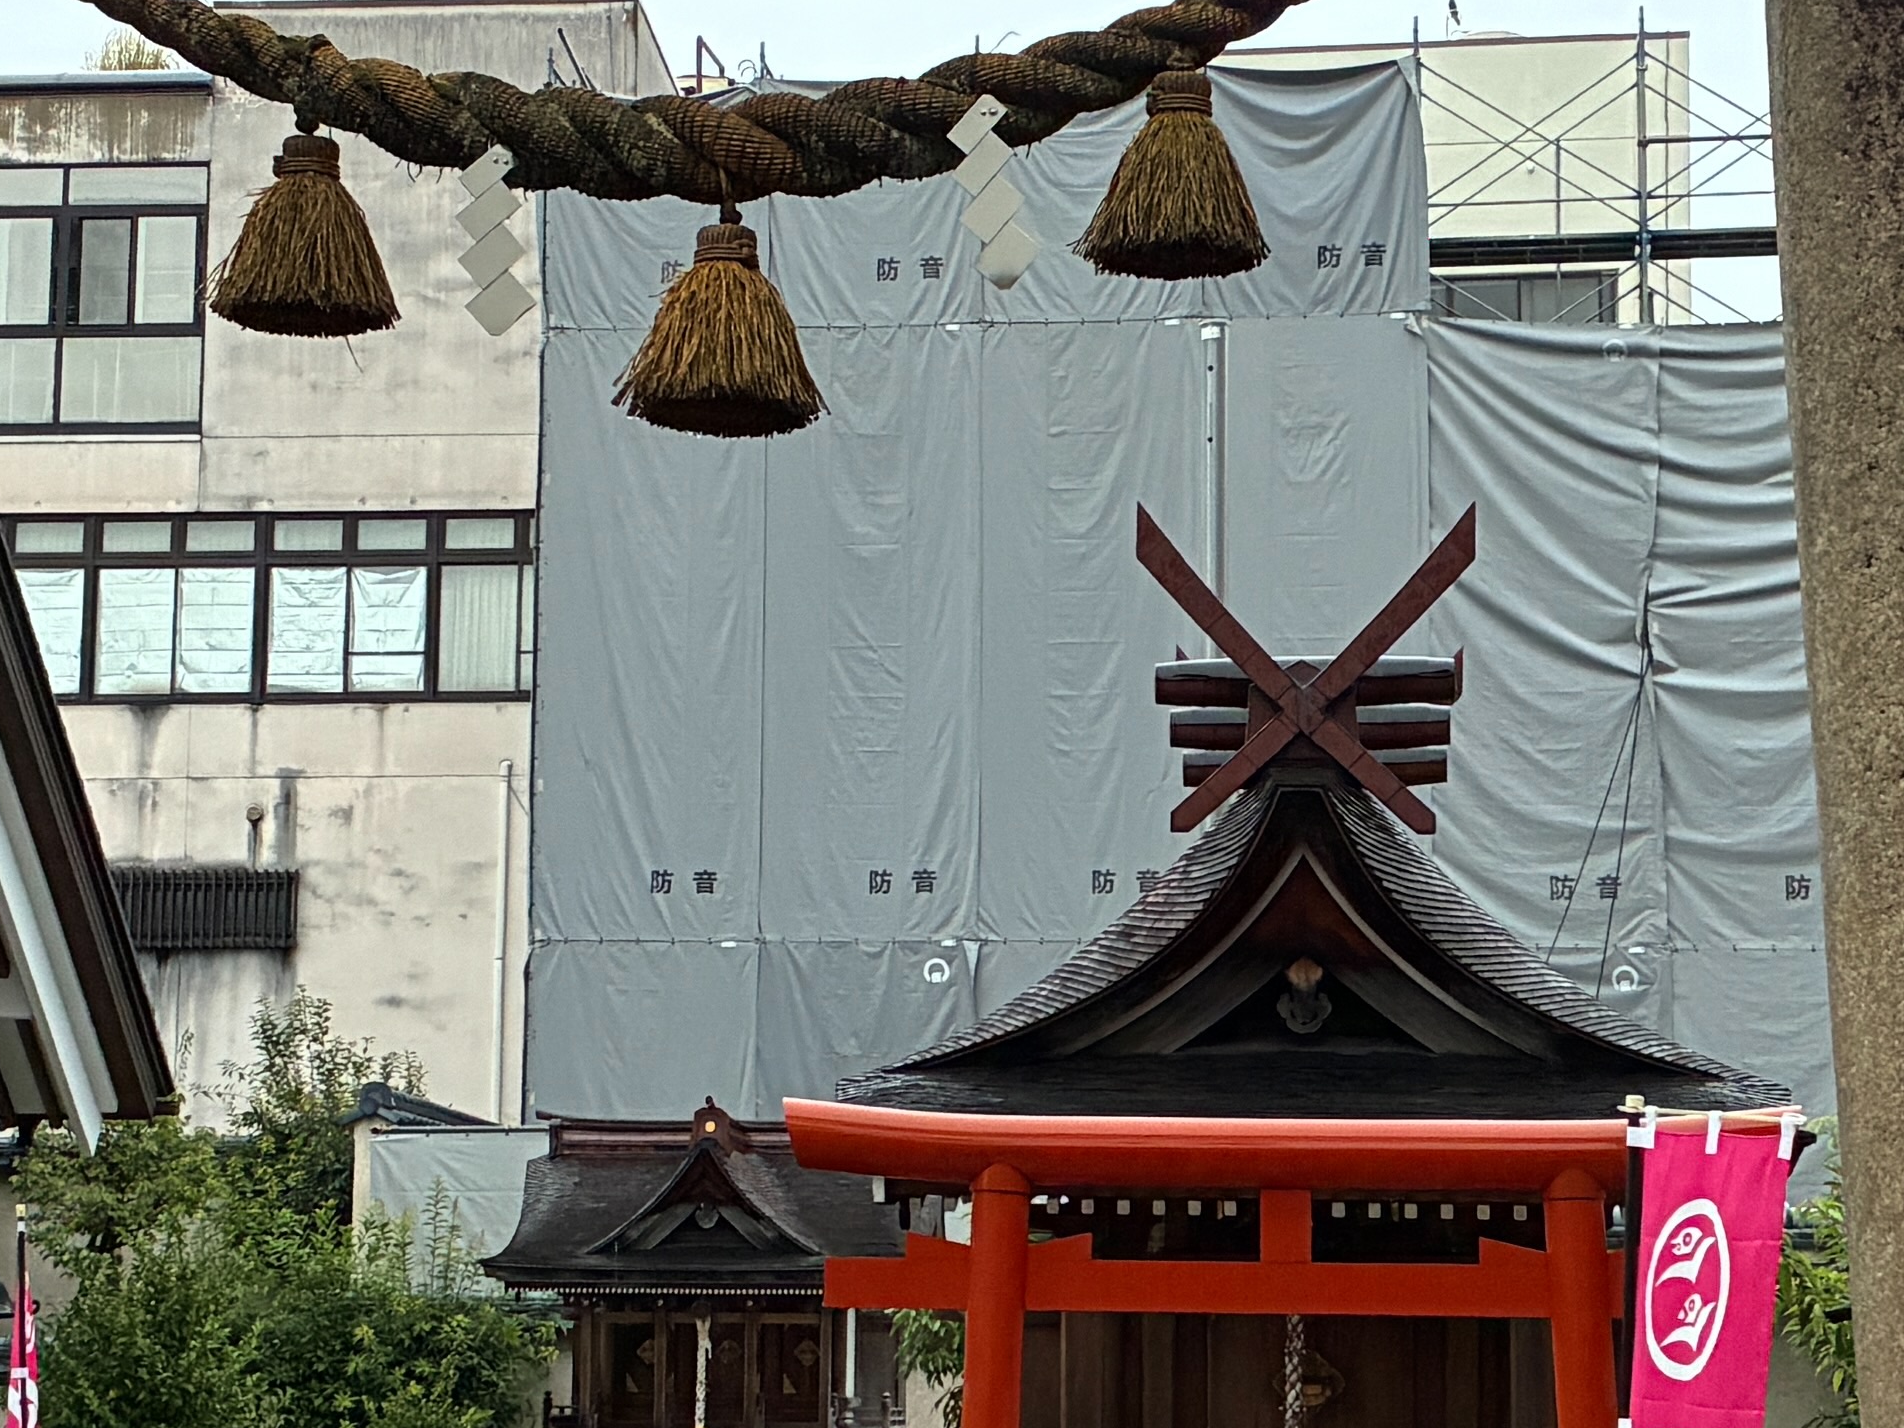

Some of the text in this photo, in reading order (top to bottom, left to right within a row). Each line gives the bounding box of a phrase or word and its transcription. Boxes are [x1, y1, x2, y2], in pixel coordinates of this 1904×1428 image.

[877, 255, 944, 282] 防音
[1318, 241, 1386, 269] 防音
[650, 869, 717, 895] 防音
[868, 868, 937, 895] 防音
[1550, 873, 1622, 901] 防音
